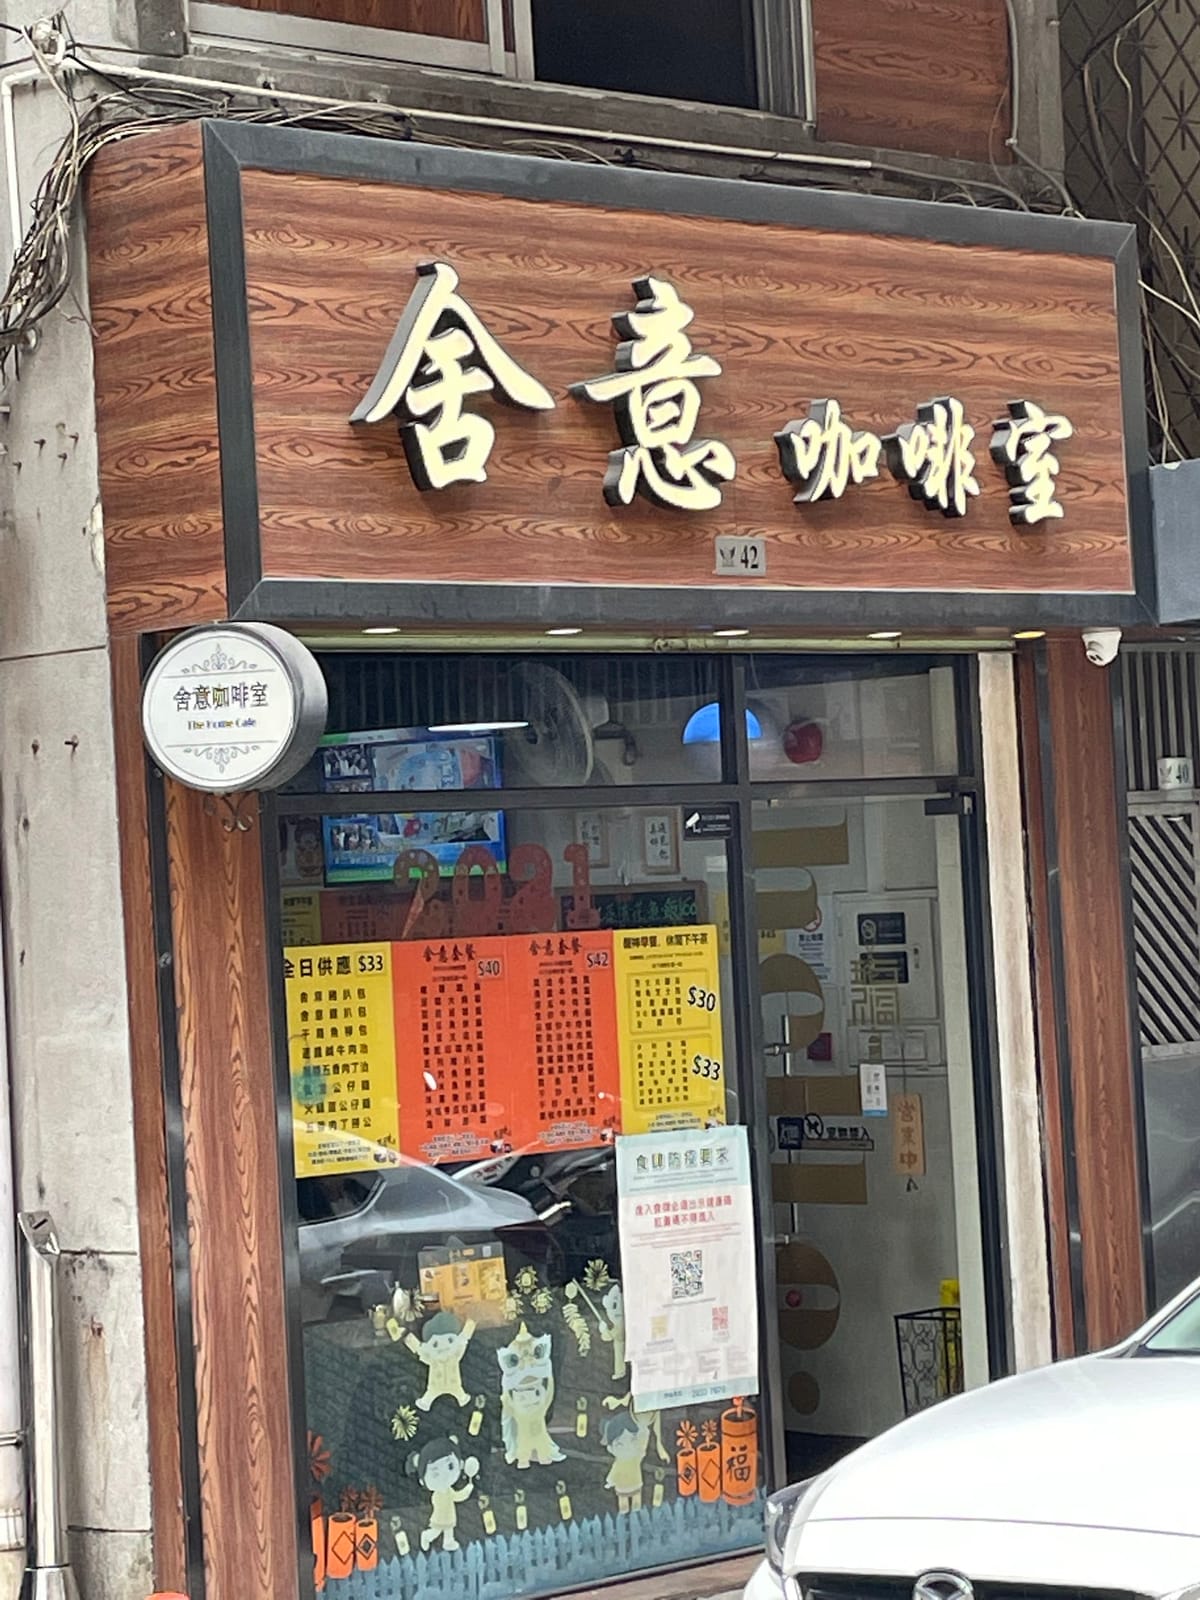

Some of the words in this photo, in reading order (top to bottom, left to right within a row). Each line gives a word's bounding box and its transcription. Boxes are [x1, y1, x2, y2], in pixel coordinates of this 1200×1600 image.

[741, 545, 758, 568] 42
[174, 682, 269, 711] 舍意咖啡室
[187, 719, 205, 730] The
[358, 955, 383, 972] $33
[687, 986, 716, 1012] $30
[692, 1055, 720, 1080] $33
[727, 1446, 751, 1482] 福
